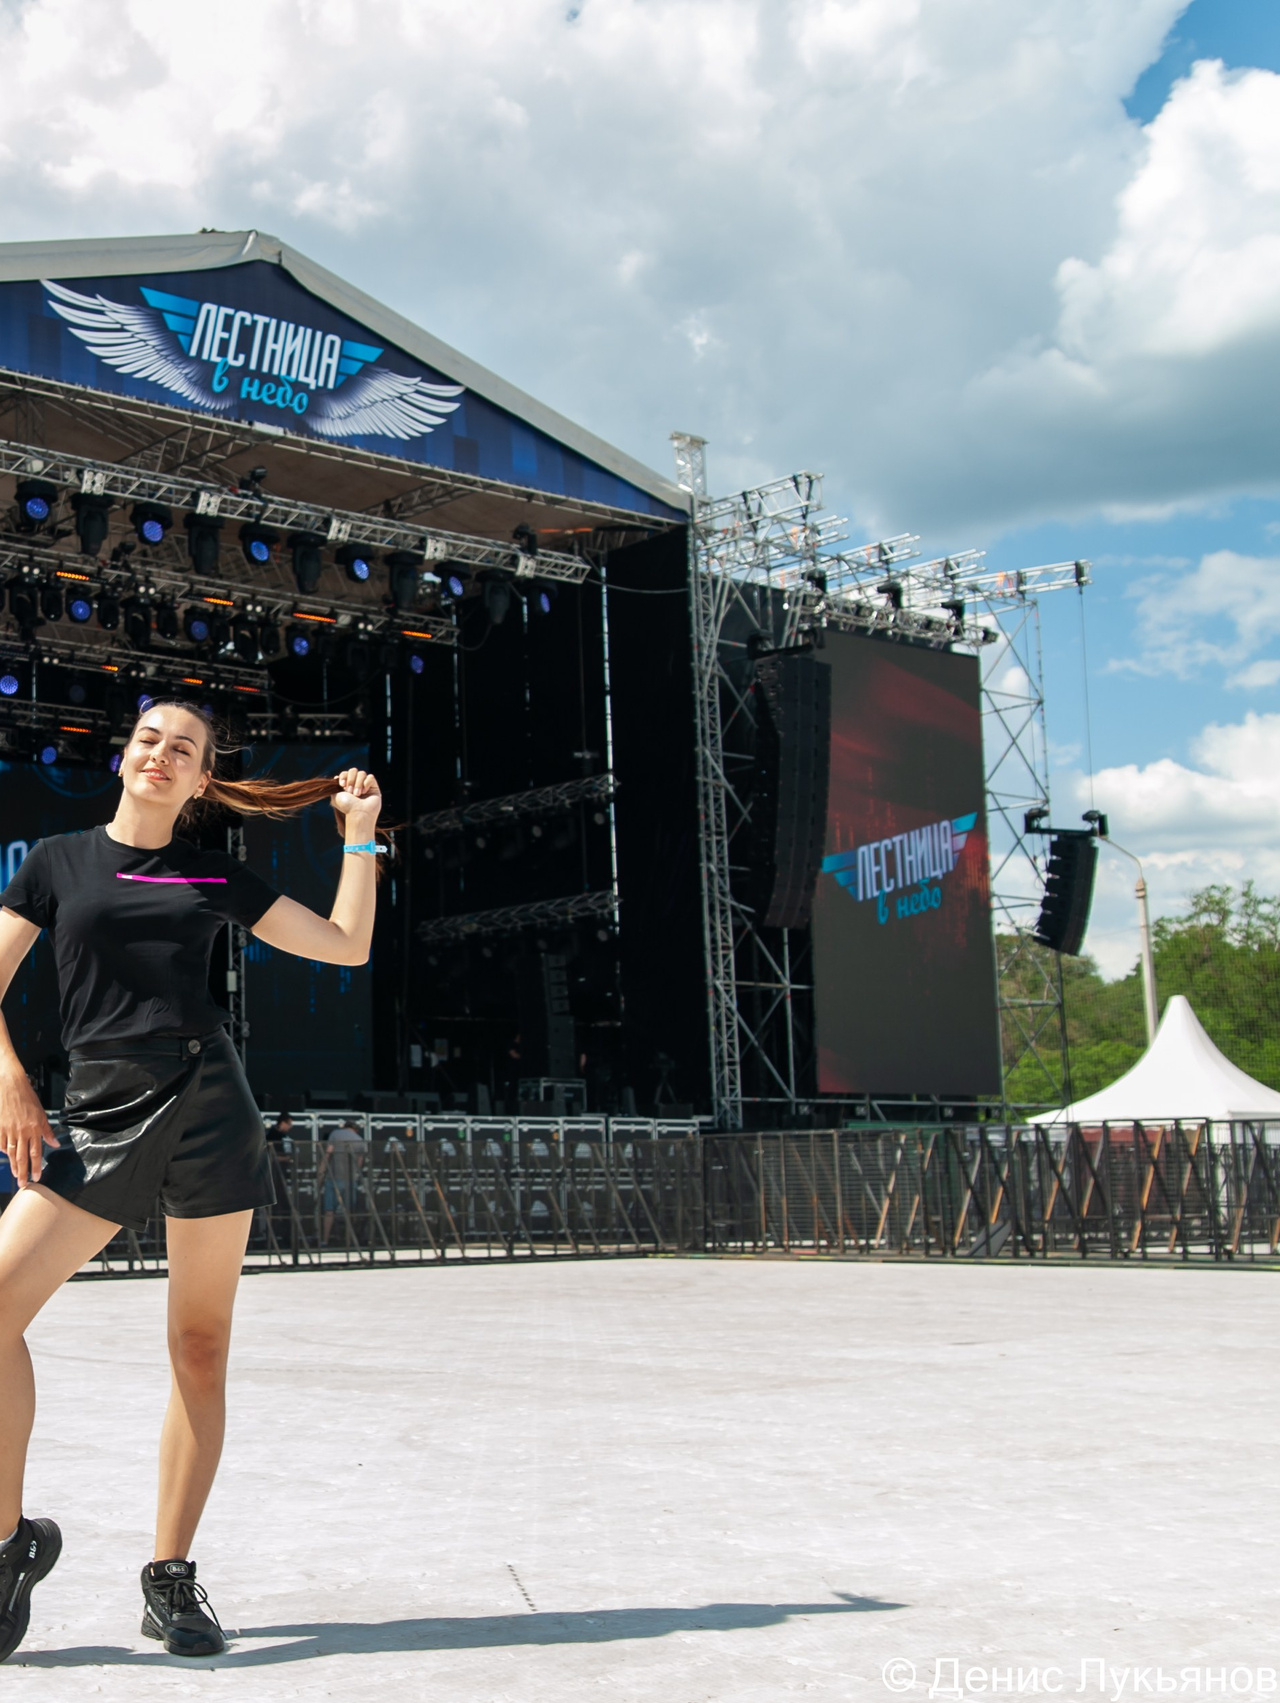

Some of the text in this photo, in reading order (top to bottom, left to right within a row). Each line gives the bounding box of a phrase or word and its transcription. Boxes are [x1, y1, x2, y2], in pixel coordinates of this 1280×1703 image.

[190, 303, 341, 390] ЛЕСТНИЦА
[212, 357, 308, 414] в небо
[858, 820, 953, 902] ЛЕСТНИЦА
[877, 880, 941, 925] в небо
